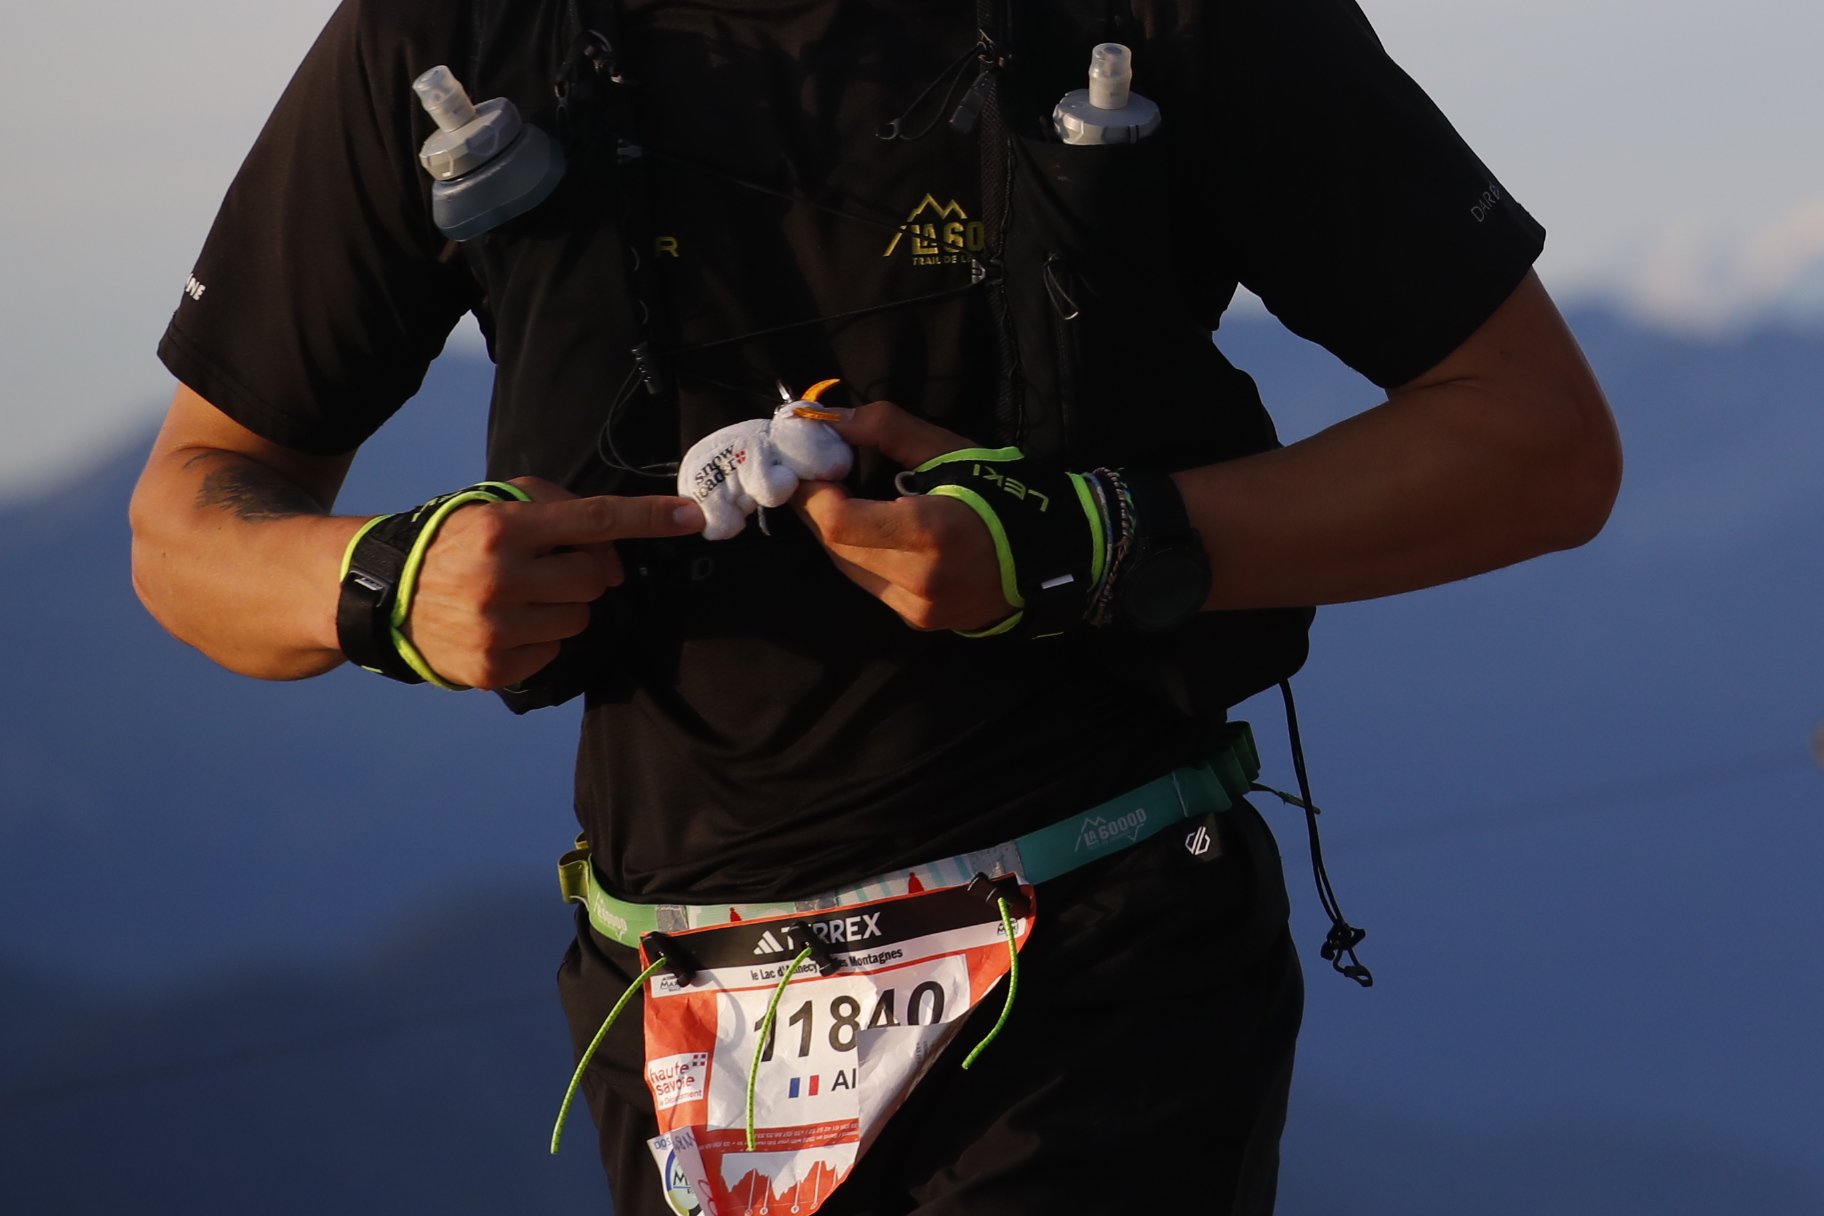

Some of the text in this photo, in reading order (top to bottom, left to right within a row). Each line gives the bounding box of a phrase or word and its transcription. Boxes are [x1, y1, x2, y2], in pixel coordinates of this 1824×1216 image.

[695, 445, 734, 485] snow
[972, 463, 1050, 513] LEKI
[1083, 829, 1099, 846] LA
[1098, 808, 1148, 840] 6000D
[781, 912, 882, 951] TRREX
[750, 970, 759, 981] le
[761, 968, 776, 980] Lac
[754, 980, 944, 1062] 11840
[650, 1062, 689, 1083] haute
[656, 1076, 695, 1095] savoie
